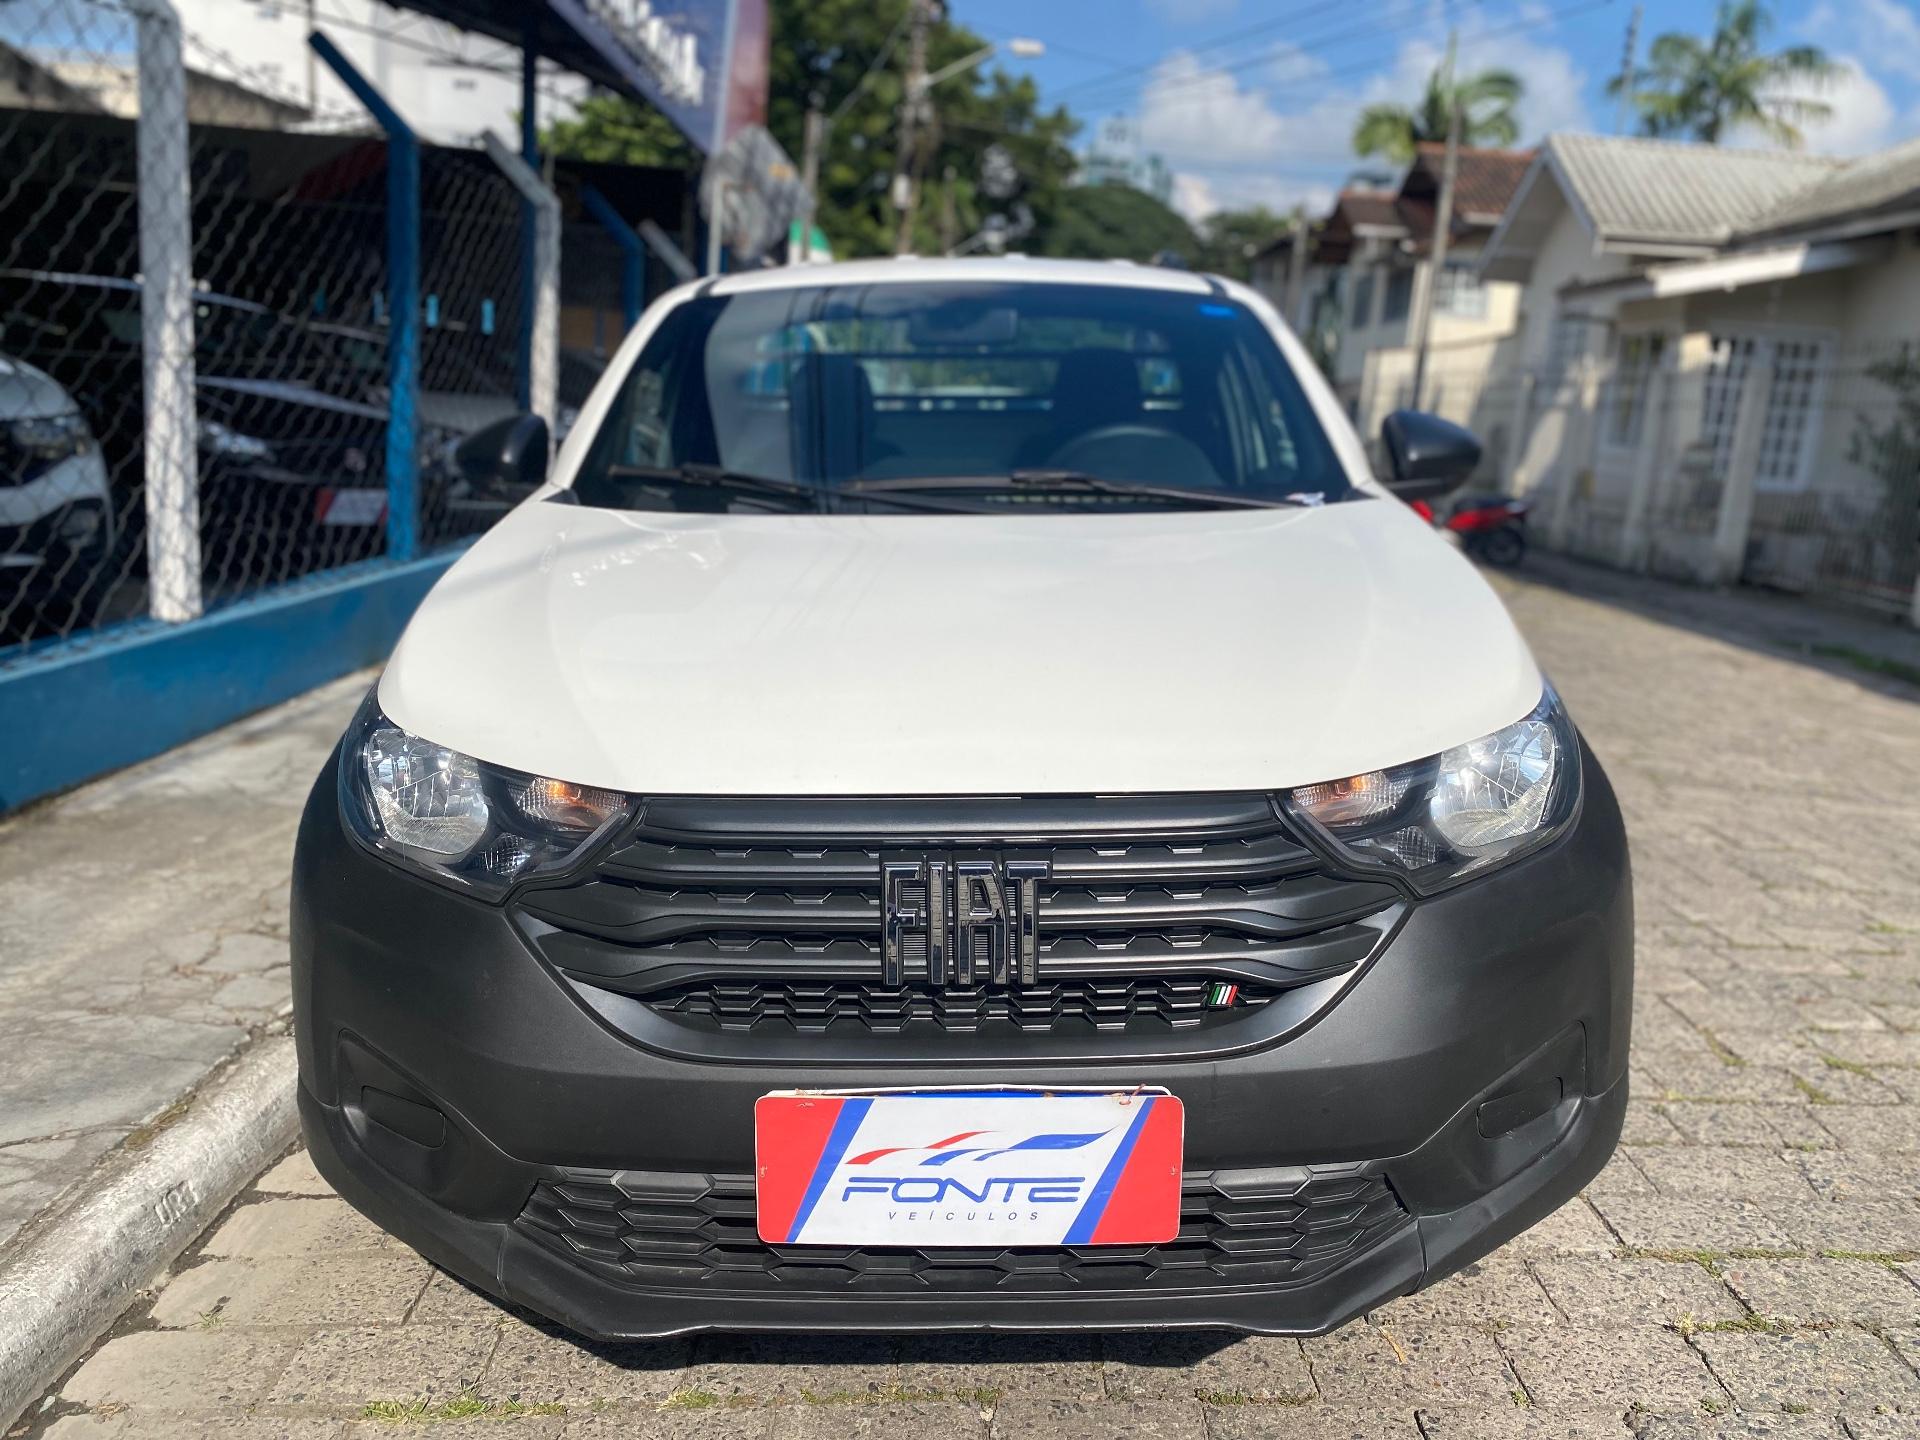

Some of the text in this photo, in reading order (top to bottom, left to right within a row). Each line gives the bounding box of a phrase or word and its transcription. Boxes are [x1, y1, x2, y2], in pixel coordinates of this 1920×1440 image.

[883, 860, 1051, 985] FIAT
[842, 1177, 1086, 1203] FONTE
[888, 1210, 1039, 1221] VEÍCULOS
